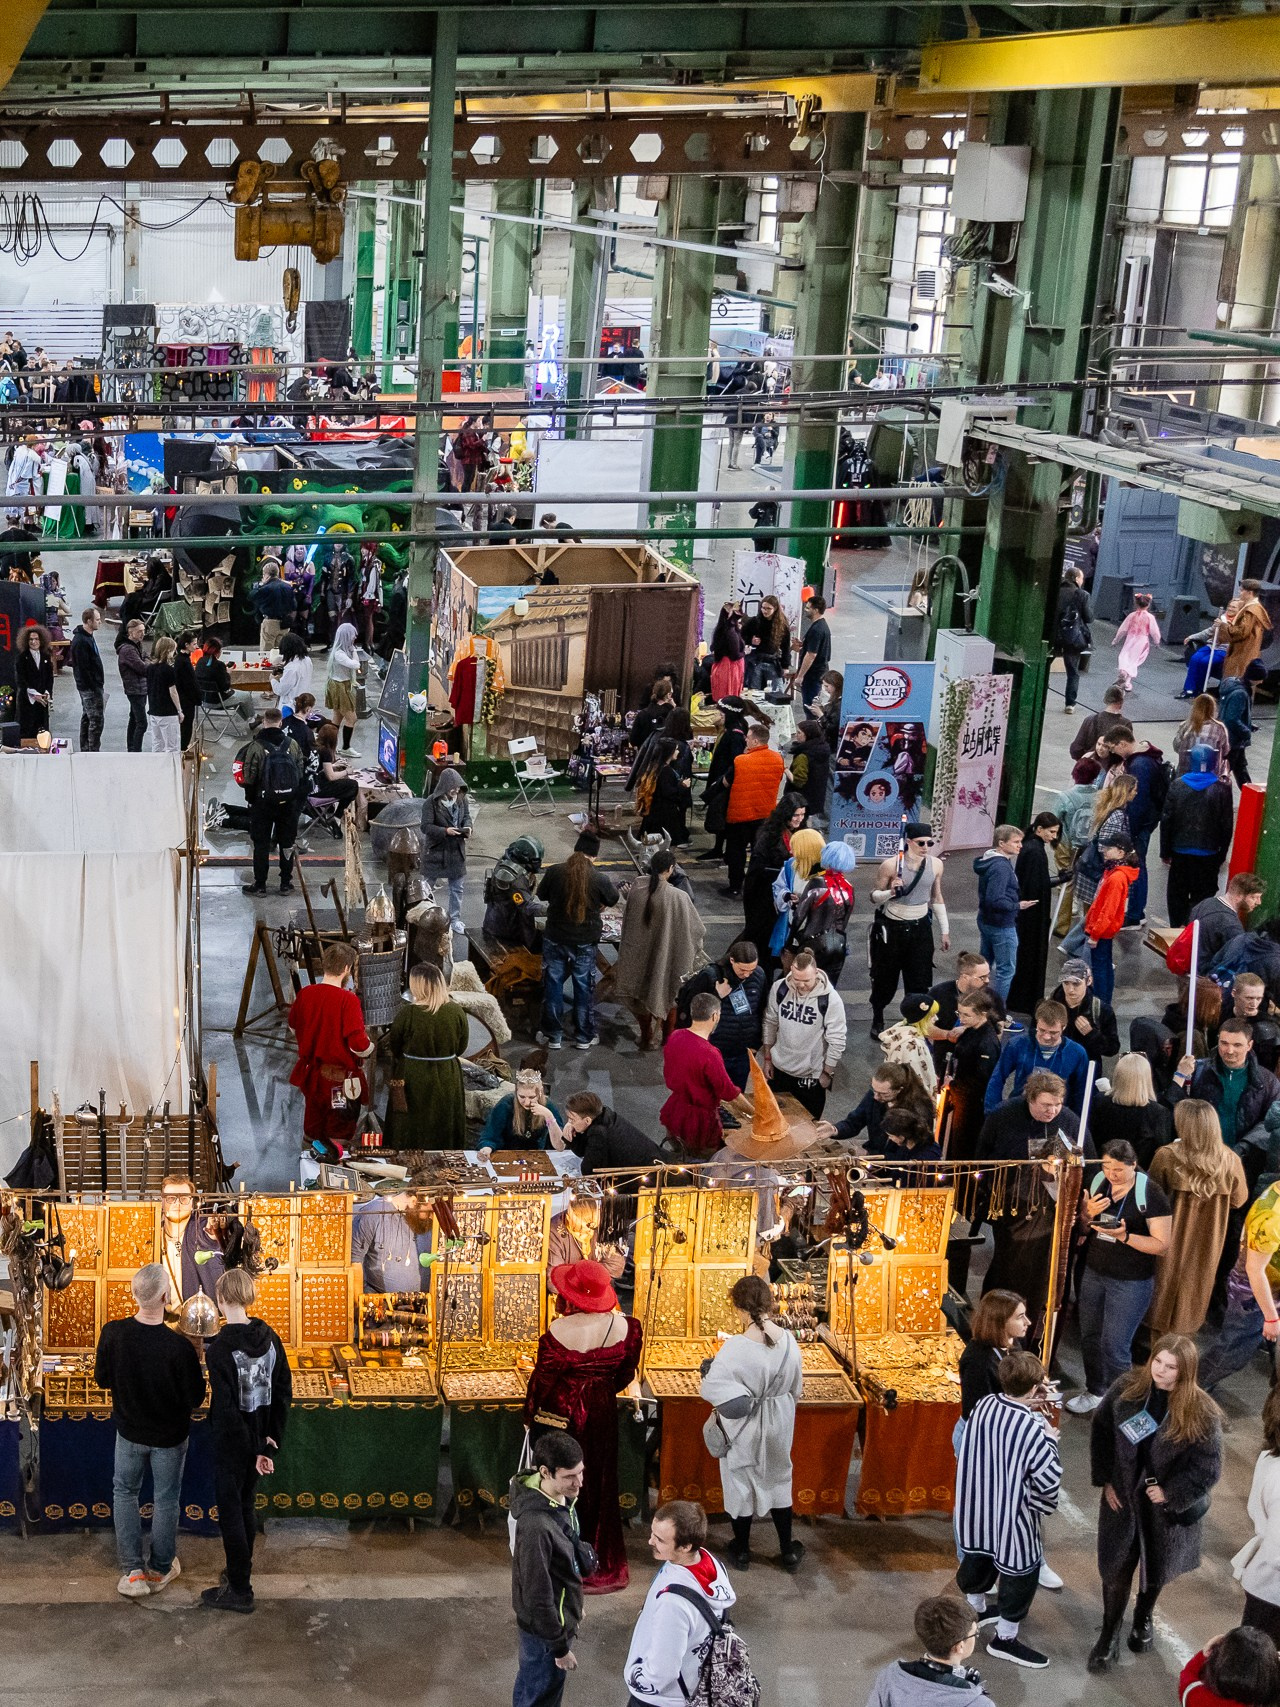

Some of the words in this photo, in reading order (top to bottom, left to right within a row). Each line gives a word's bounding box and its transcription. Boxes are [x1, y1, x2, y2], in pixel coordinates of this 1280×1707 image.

[863, 674, 910, 687] DEMON
[861, 687, 908, 699] SLAYER
[780, 1007, 817, 1025] WARS
[781, 1000, 817, 1017] STAR
